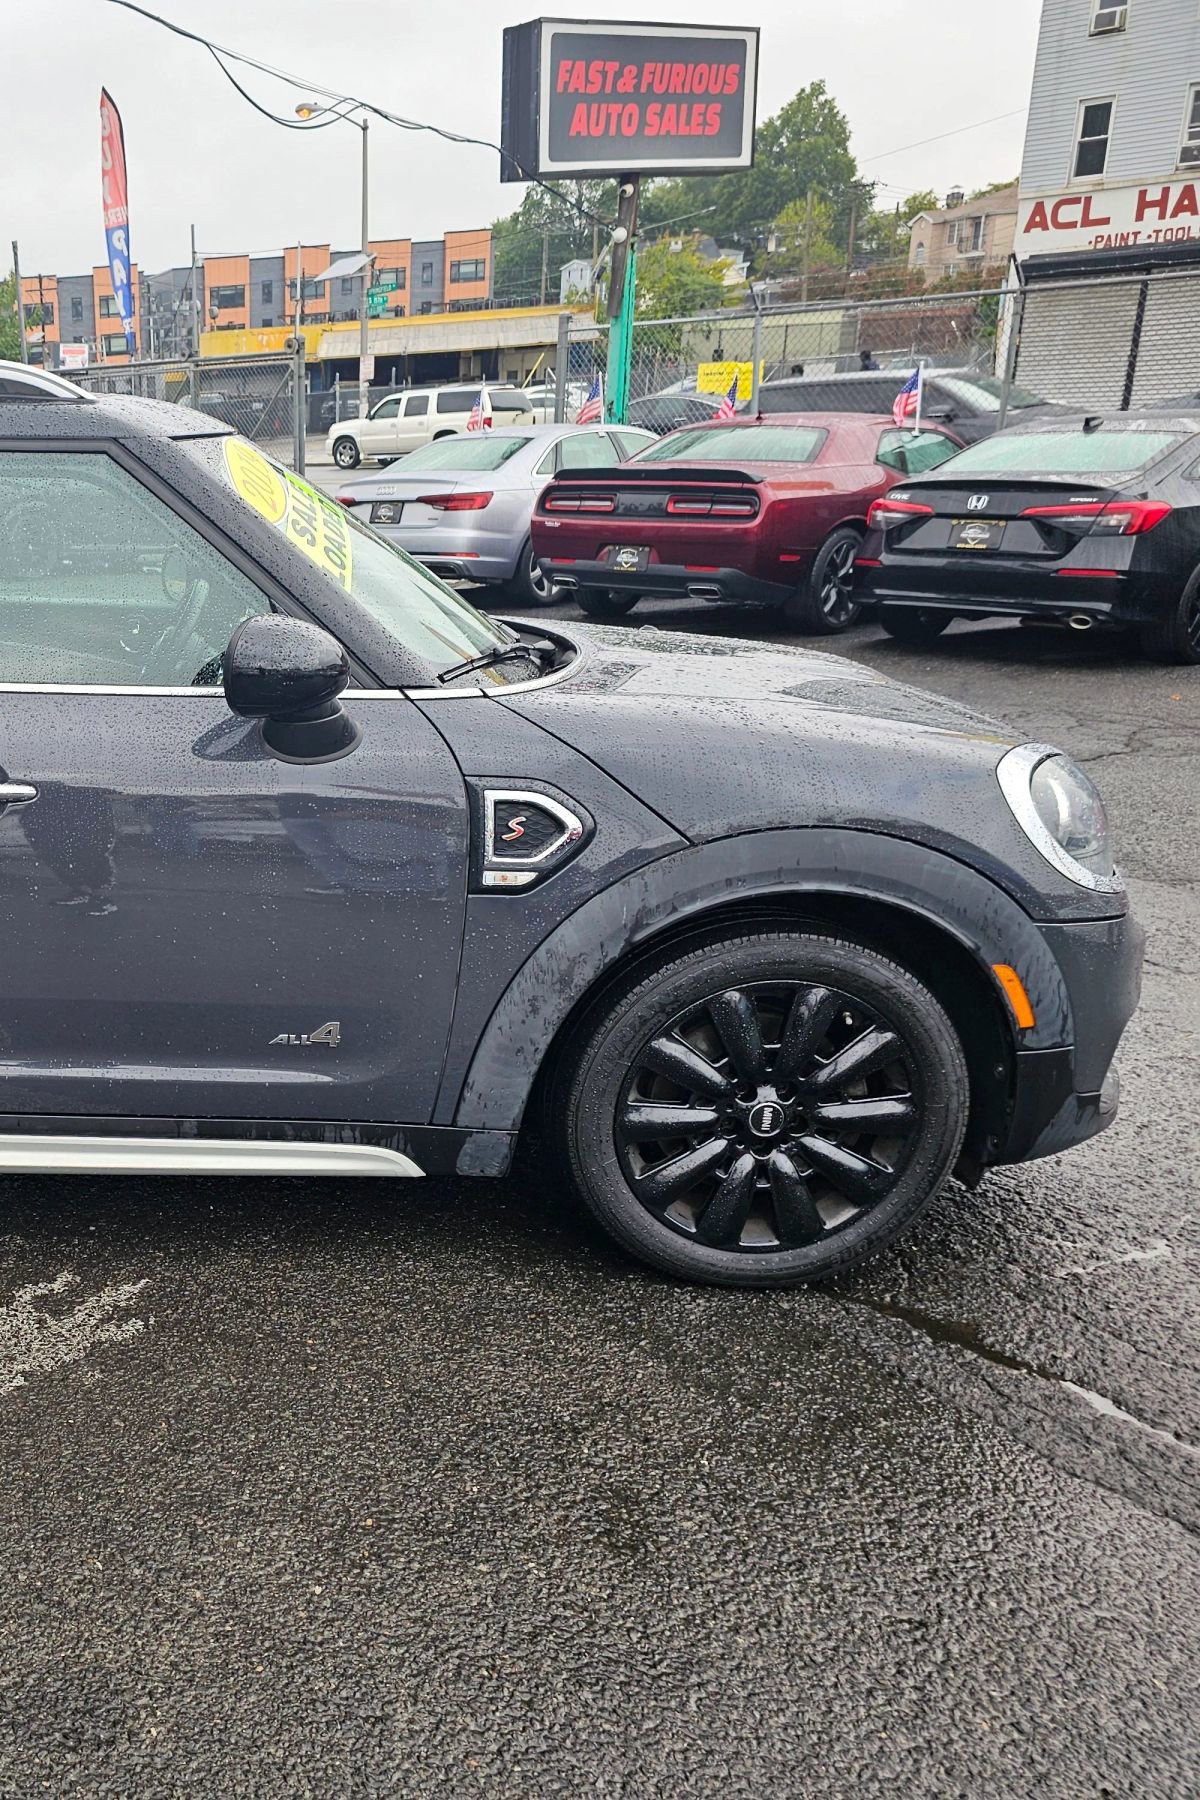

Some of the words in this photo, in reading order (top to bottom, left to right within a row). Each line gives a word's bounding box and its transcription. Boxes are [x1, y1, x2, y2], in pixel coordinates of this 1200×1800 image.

[556, 60, 620, 94] FAST
[616, 64, 638, 94] &
[640, 62, 741, 95] FURIOUS
[568, 103, 639, 137] AUTO
[643, 103, 722, 137] SALES
[1023, 195, 1111, 233] ACL
[1135, 183, 1200, 222] HA
[1094, 230, 1142, 250] PAINT
[1152, 225, 1200, 243] TOOL
[501, 815, 527, 842] S
[760, 1107, 774, 1131] MINI
